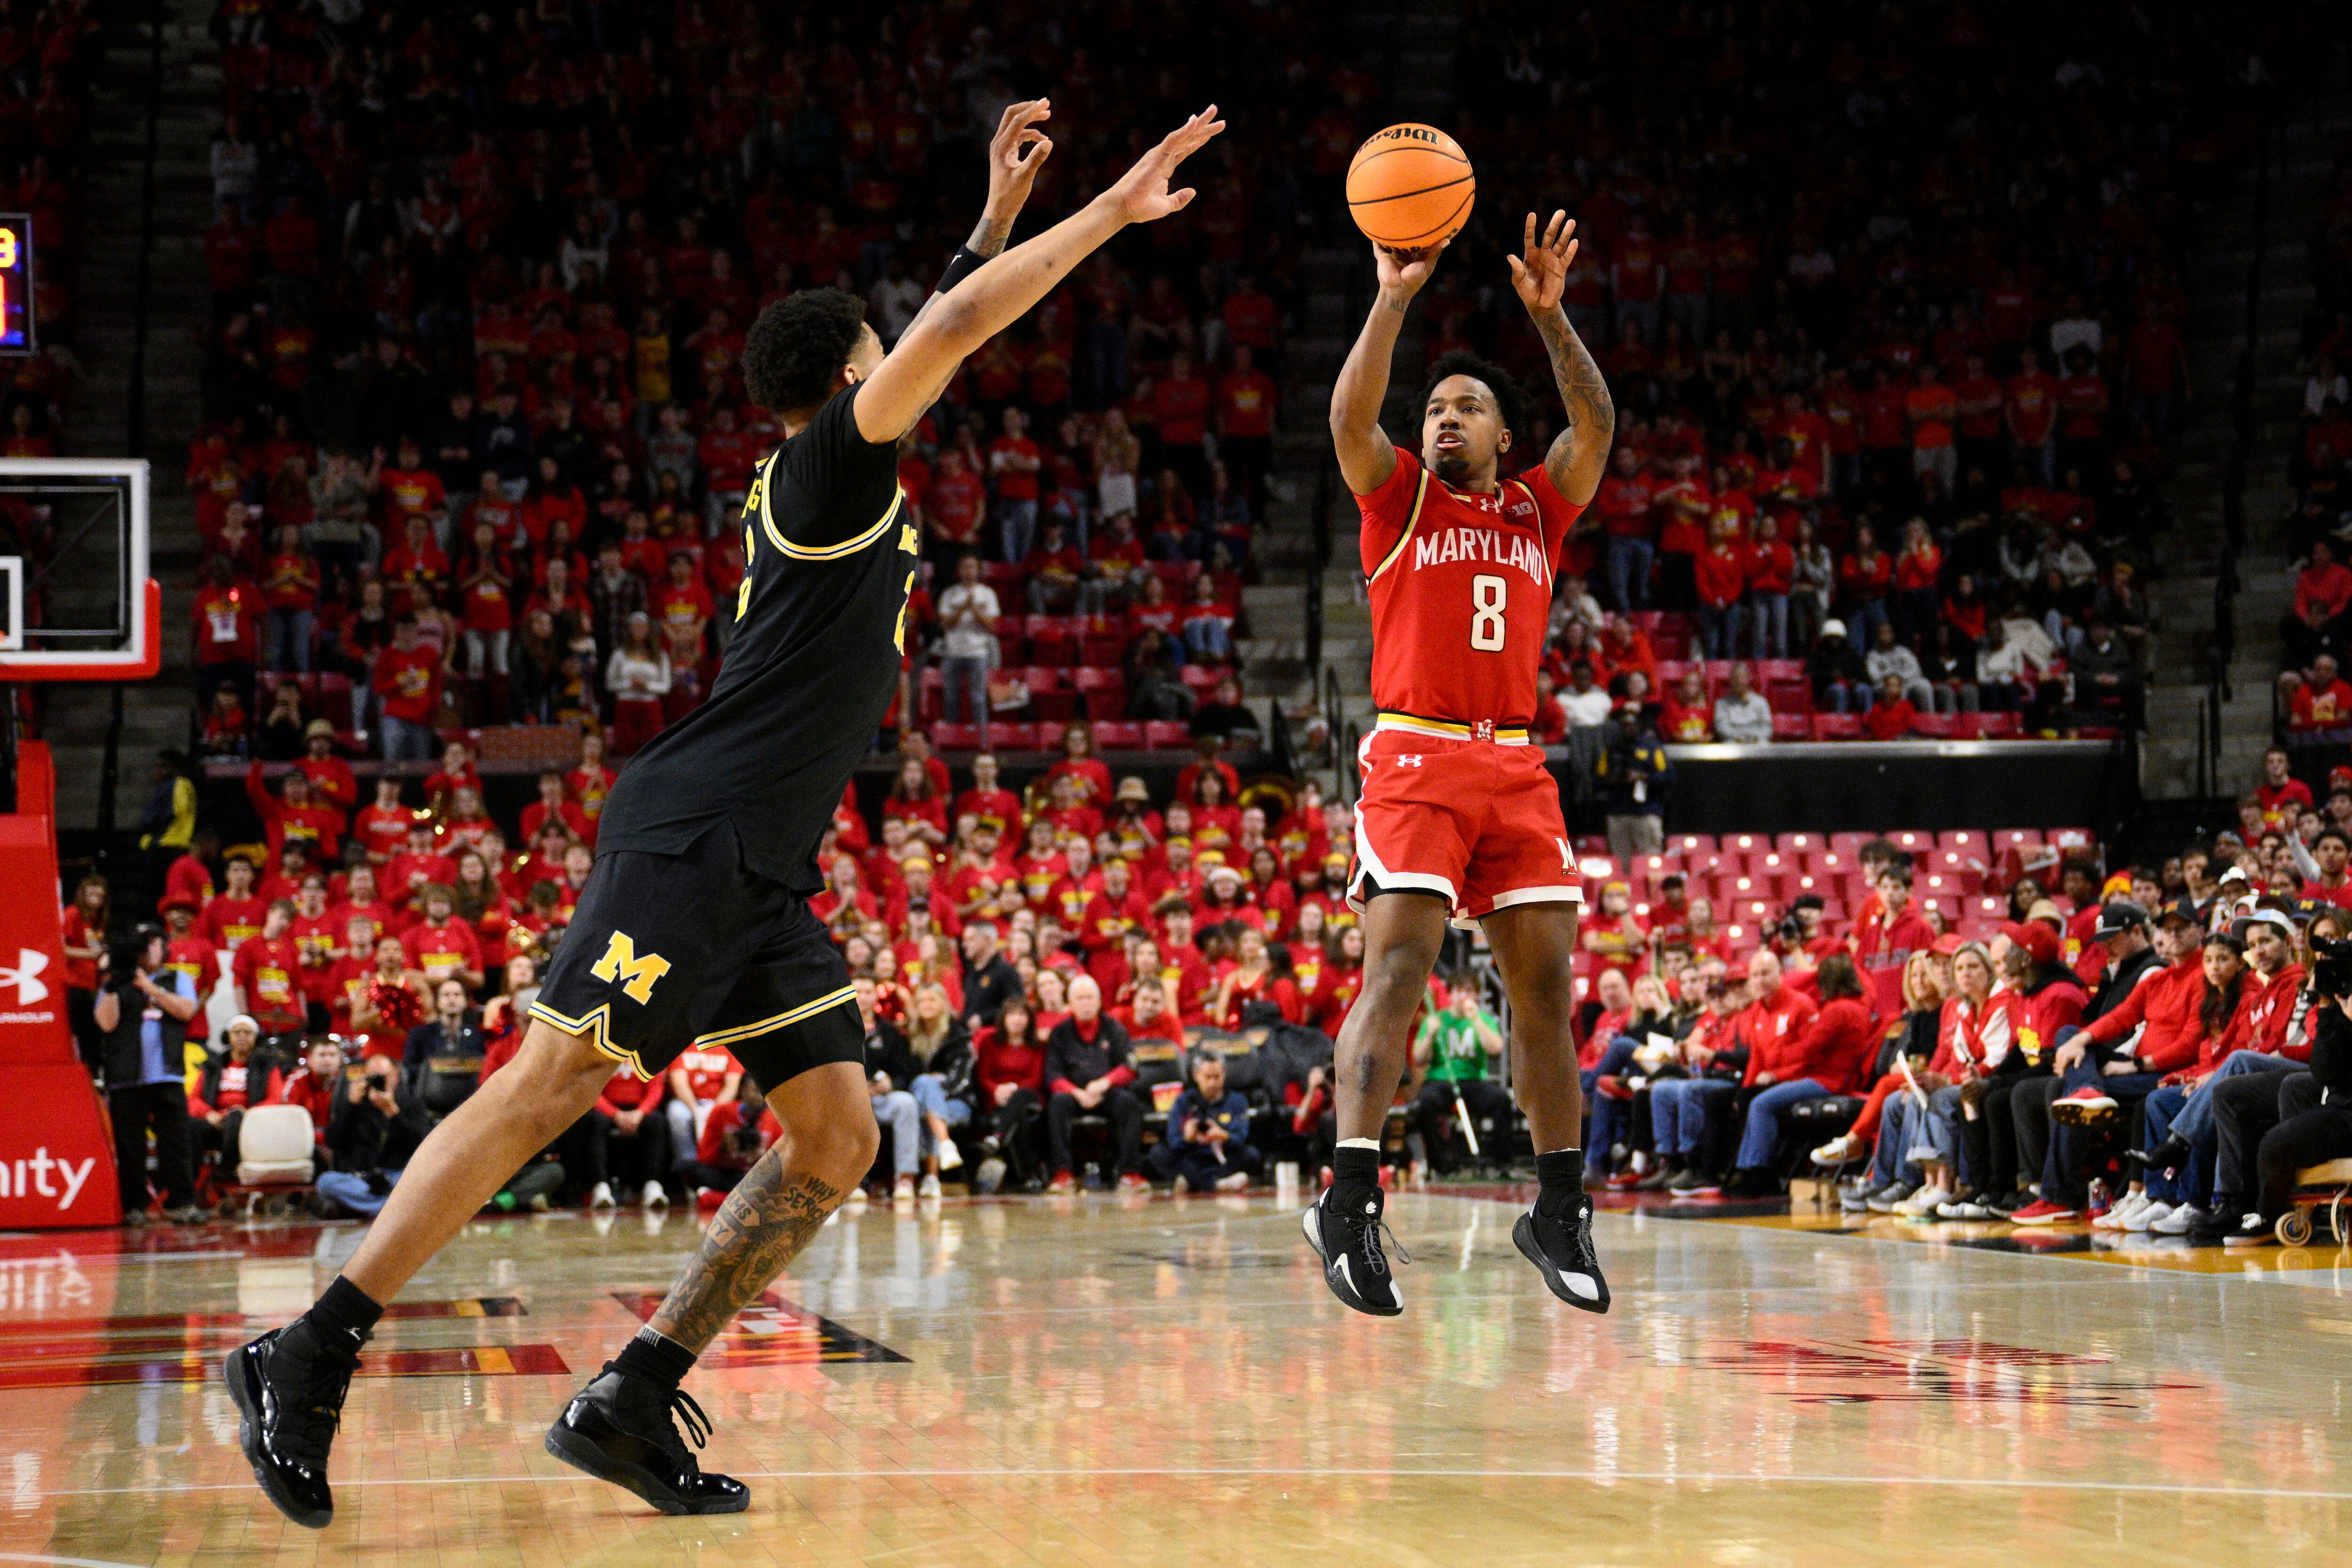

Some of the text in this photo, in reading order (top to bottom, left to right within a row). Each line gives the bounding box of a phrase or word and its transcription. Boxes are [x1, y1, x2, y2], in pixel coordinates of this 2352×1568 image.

[1414, 527, 1542, 586] MARYLAND
[1471, 574, 1507, 652] 8
[590, 930, 671, 1006] M
[1448, 1027, 1475, 1058] M
[804, 1177, 839, 1203] WHY
